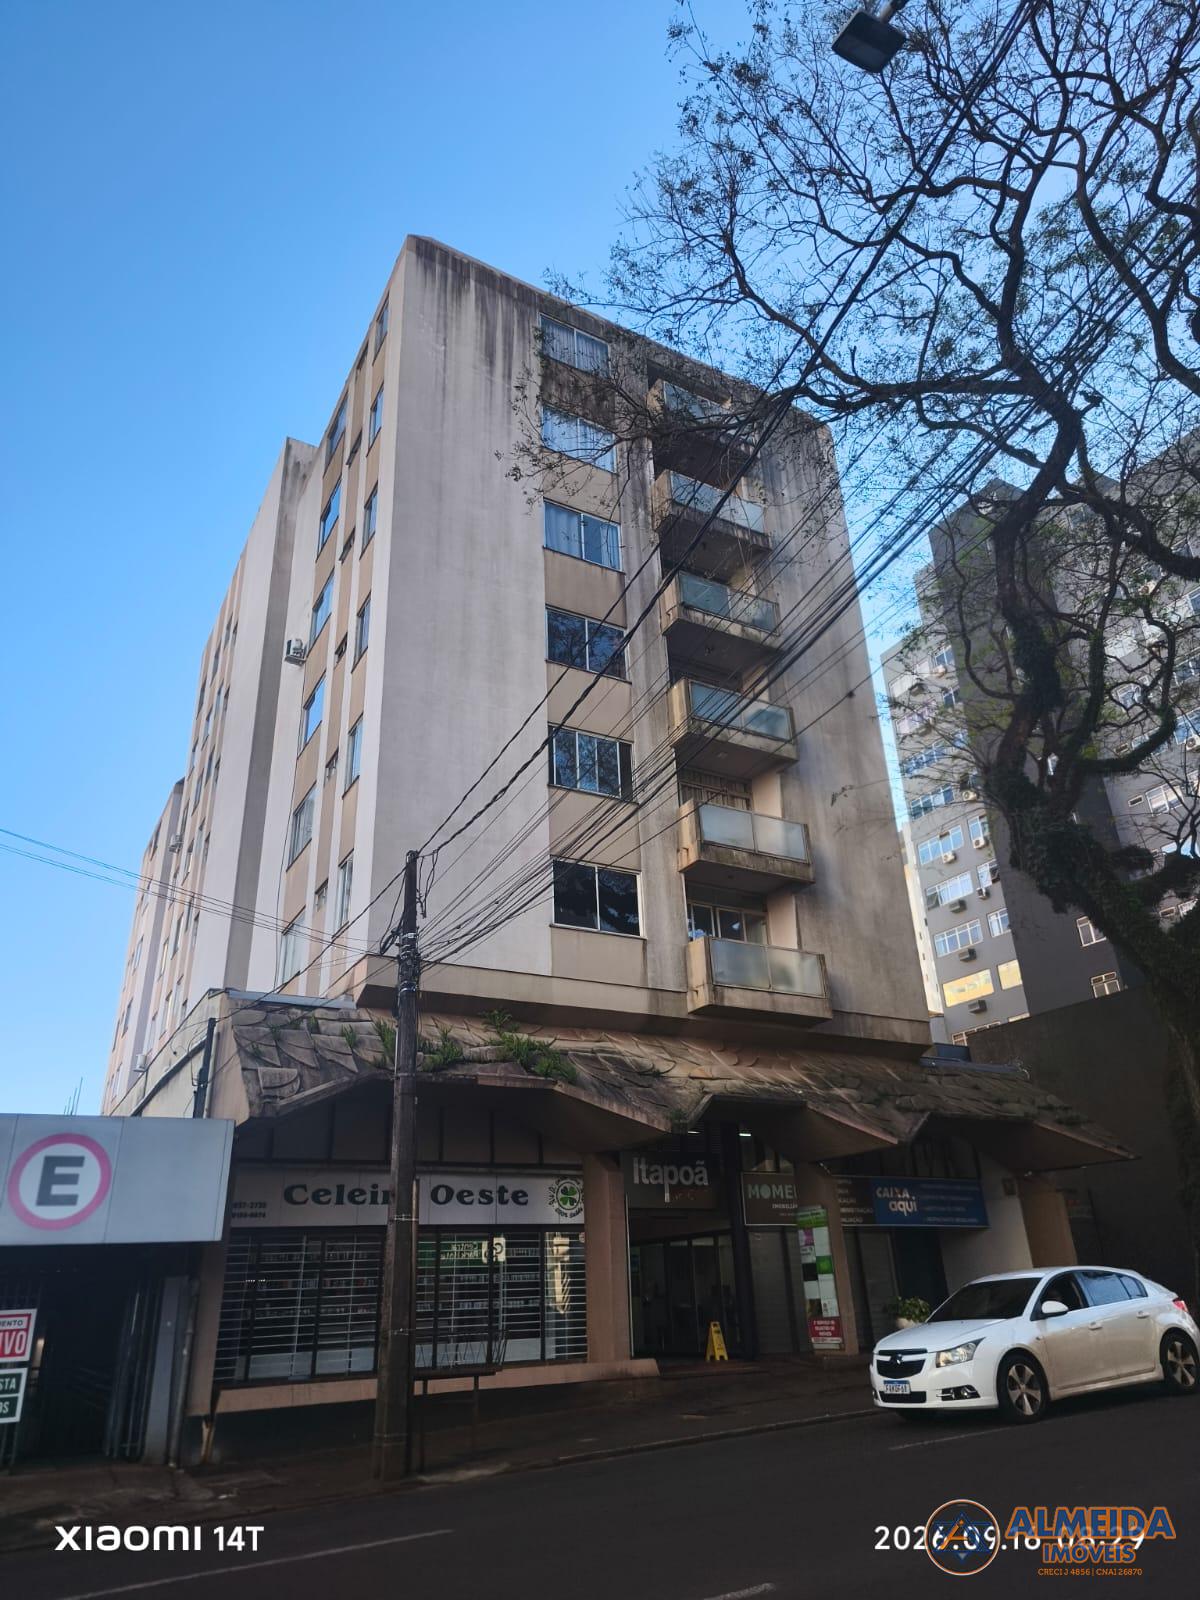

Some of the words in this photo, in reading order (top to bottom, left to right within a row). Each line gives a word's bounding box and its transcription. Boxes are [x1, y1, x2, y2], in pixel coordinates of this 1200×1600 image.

[35, 1155, 85, 1206] E
[633, 1157, 709, 1203] Itapoã
[283, 1184, 391, 1206] Celeir
[430, 1184, 529, 1206] Oeste
[876, 1186, 910, 1199] CAIXA
[0, 1319, 23, 1328] ENTO
[0, 1331, 27, 1356] IVO
[0, 1377, 16, 1390] STA
